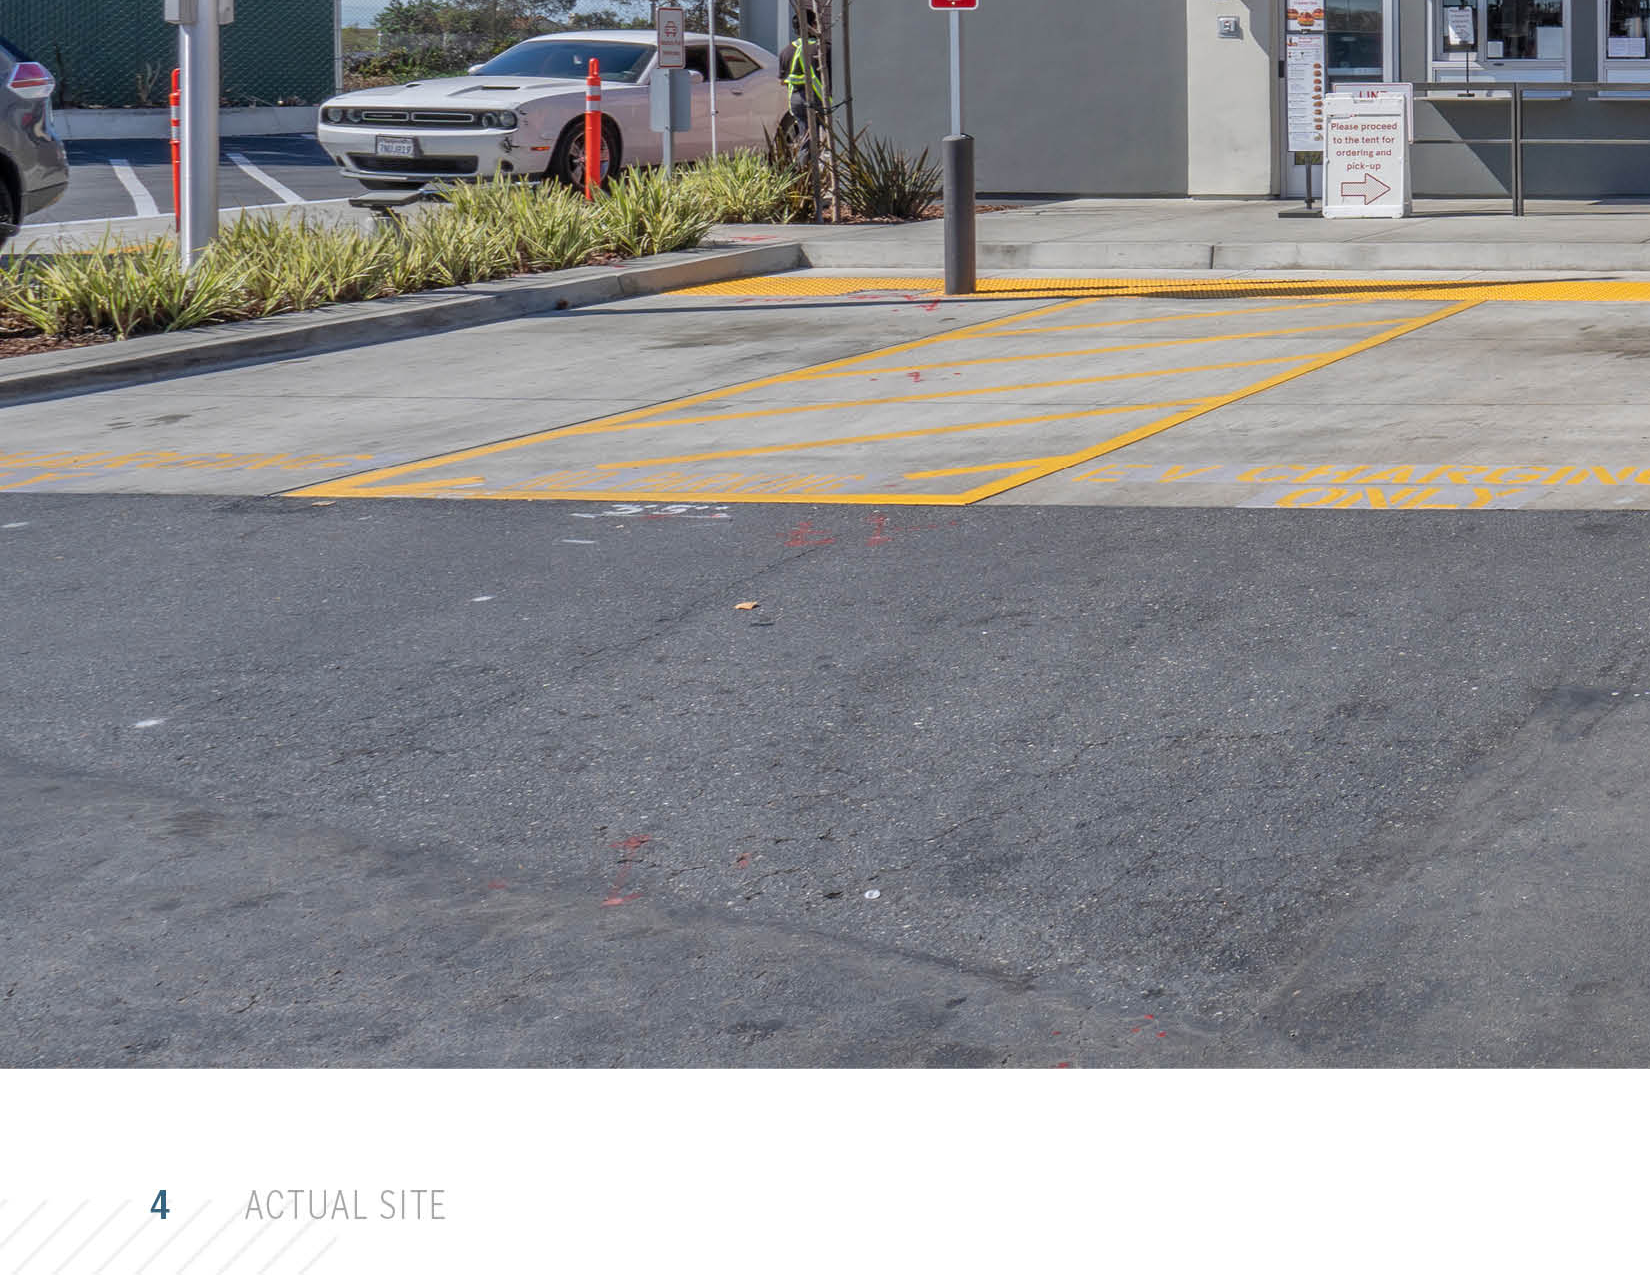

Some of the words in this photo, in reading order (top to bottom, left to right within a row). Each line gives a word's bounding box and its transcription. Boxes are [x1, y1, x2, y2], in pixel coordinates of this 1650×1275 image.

[1330, 122, 1358, 131] Please
[1360, 122, 1398, 133] proceed
[1332, 136, 1343, 144] to
[1345, 135, 1360, 144] the
[1361, 136, 1380, 144] tent
[1381, 135, 1395, 144] for
[1335, 148, 1374, 158] ordering
[1374, 148, 1392, 157] and
[1346, 161, 1382, 172] pick-up
[1275, 487, 1527, 509] ONLY
